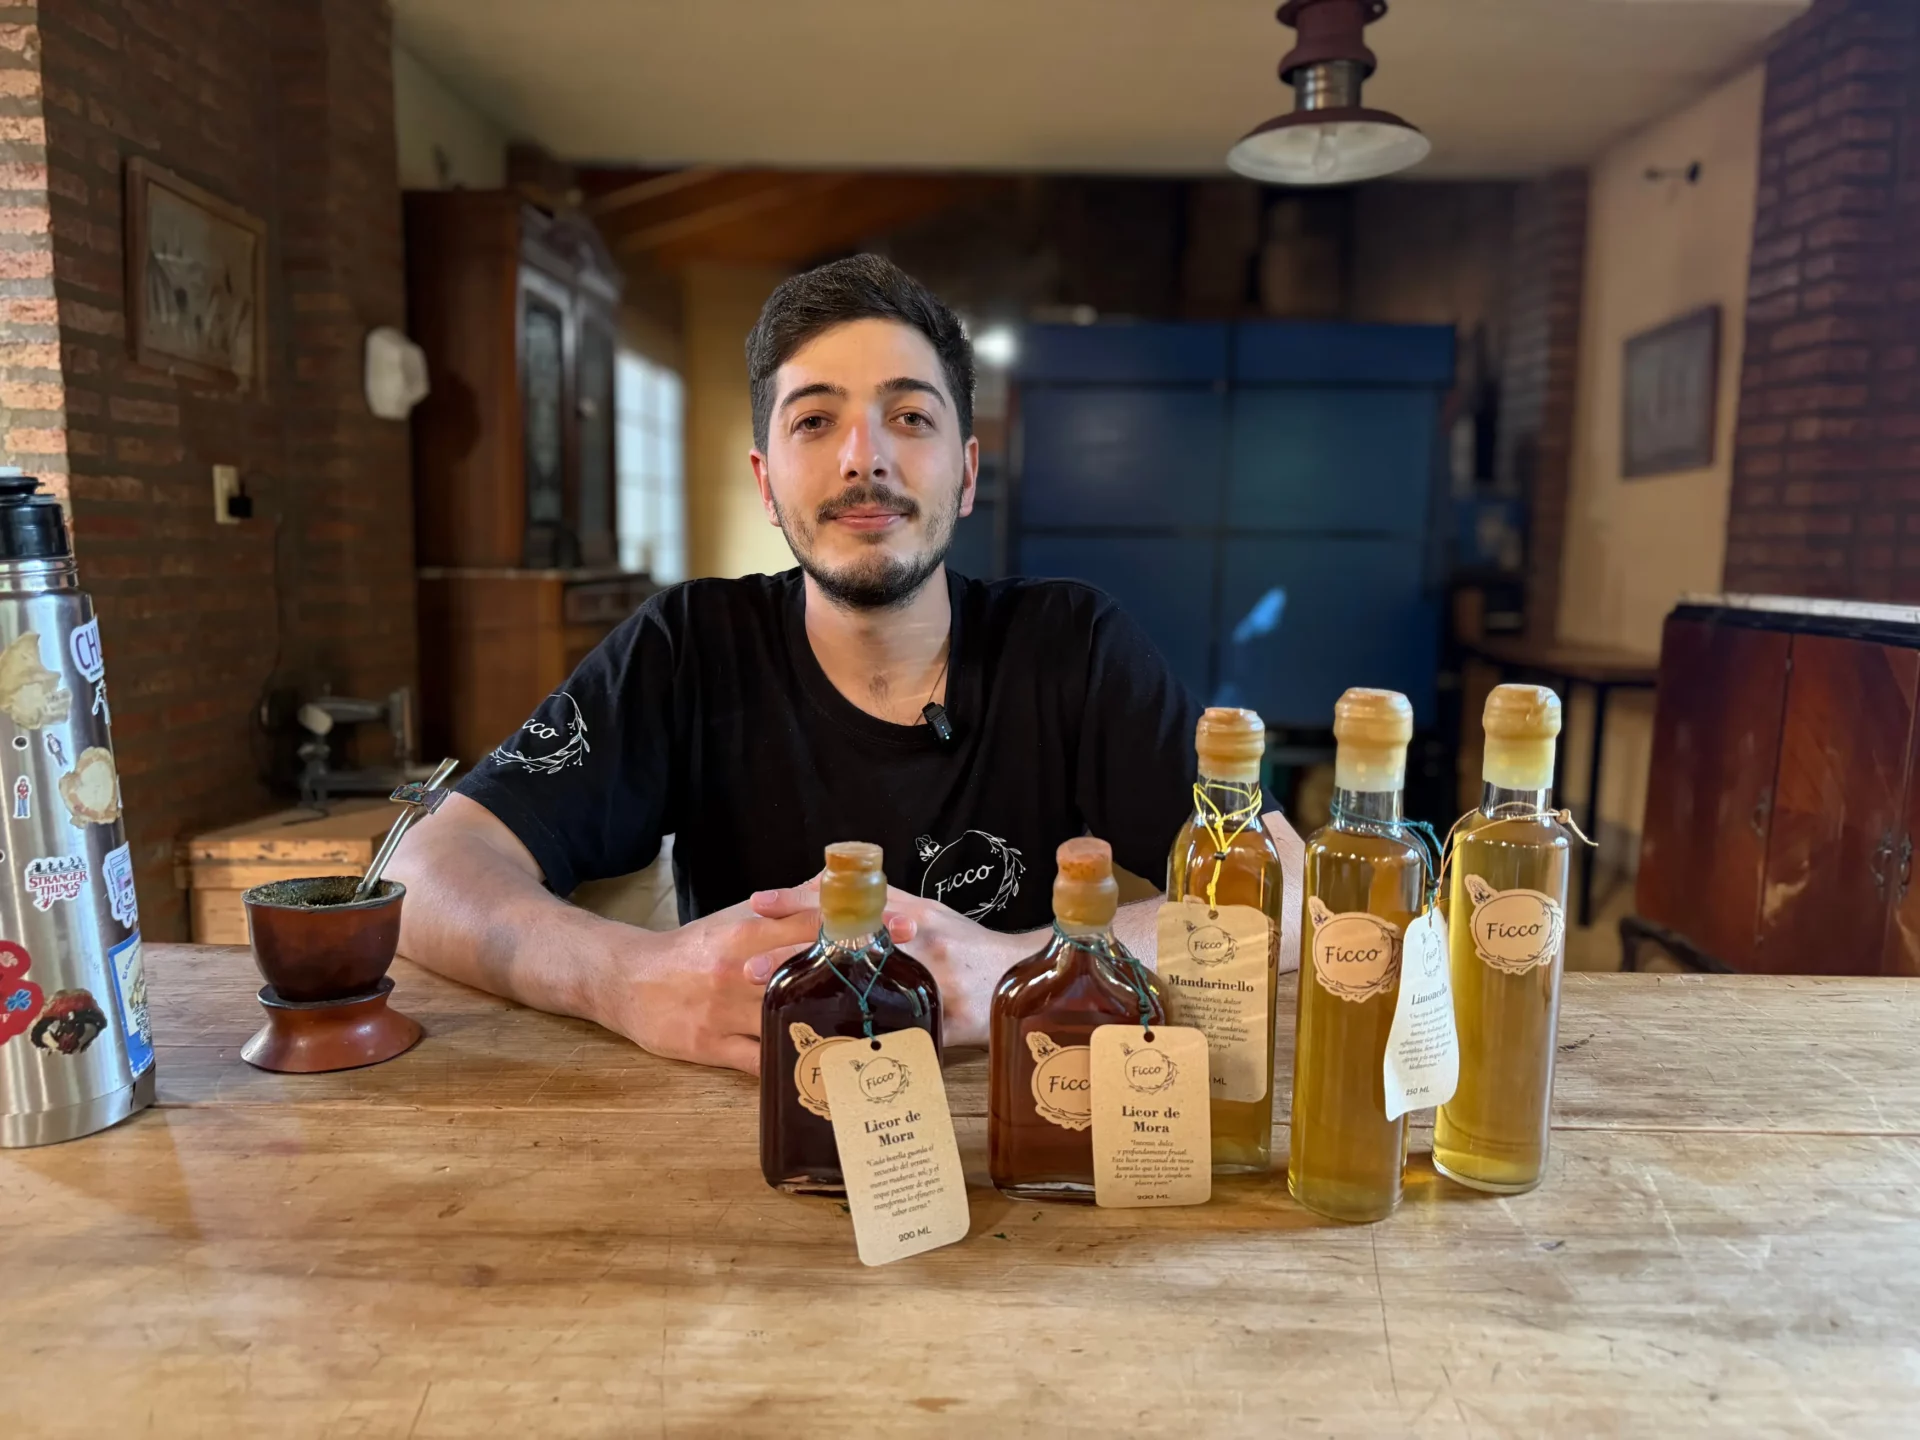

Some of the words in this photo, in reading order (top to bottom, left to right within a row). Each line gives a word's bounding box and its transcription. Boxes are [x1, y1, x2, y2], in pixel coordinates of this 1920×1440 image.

[29, 871, 88, 888] STRANGER
[935, 865, 994, 902] Ficco
[40, 880, 81, 896] THINGS
[1487, 922, 1543, 940] Ficco
[1194, 940, 1224, 951] Ficco
[1325, 945, 1382, 964] Ficco
[1168, 974, 1255, 993] Mandarinello
[1132, 1066, 1163, 1077] Ficco
[866, 1072, 896, 1090] Ficco
[1049, 1075, 1091, 1093] Ficc
[1213, 1077, 1227, 1086] ML
[1406, 1087, 1418, 1096] 250
[1420, 1086, 1430, 1094] ML
[1122, 1105, 1159, 1118] Licor
[1163, 1107, 1180, 1119] de
[864, 1117, 901, 1133] Licor
[905, 1110, 921, 1122] de
[1133, 1121, 1170, 1133] Mora
[879, 1132, 915, 1147] Mora
[899, 1230, 916, 1242] 200
[917, 1226, 932, 1237] ML
